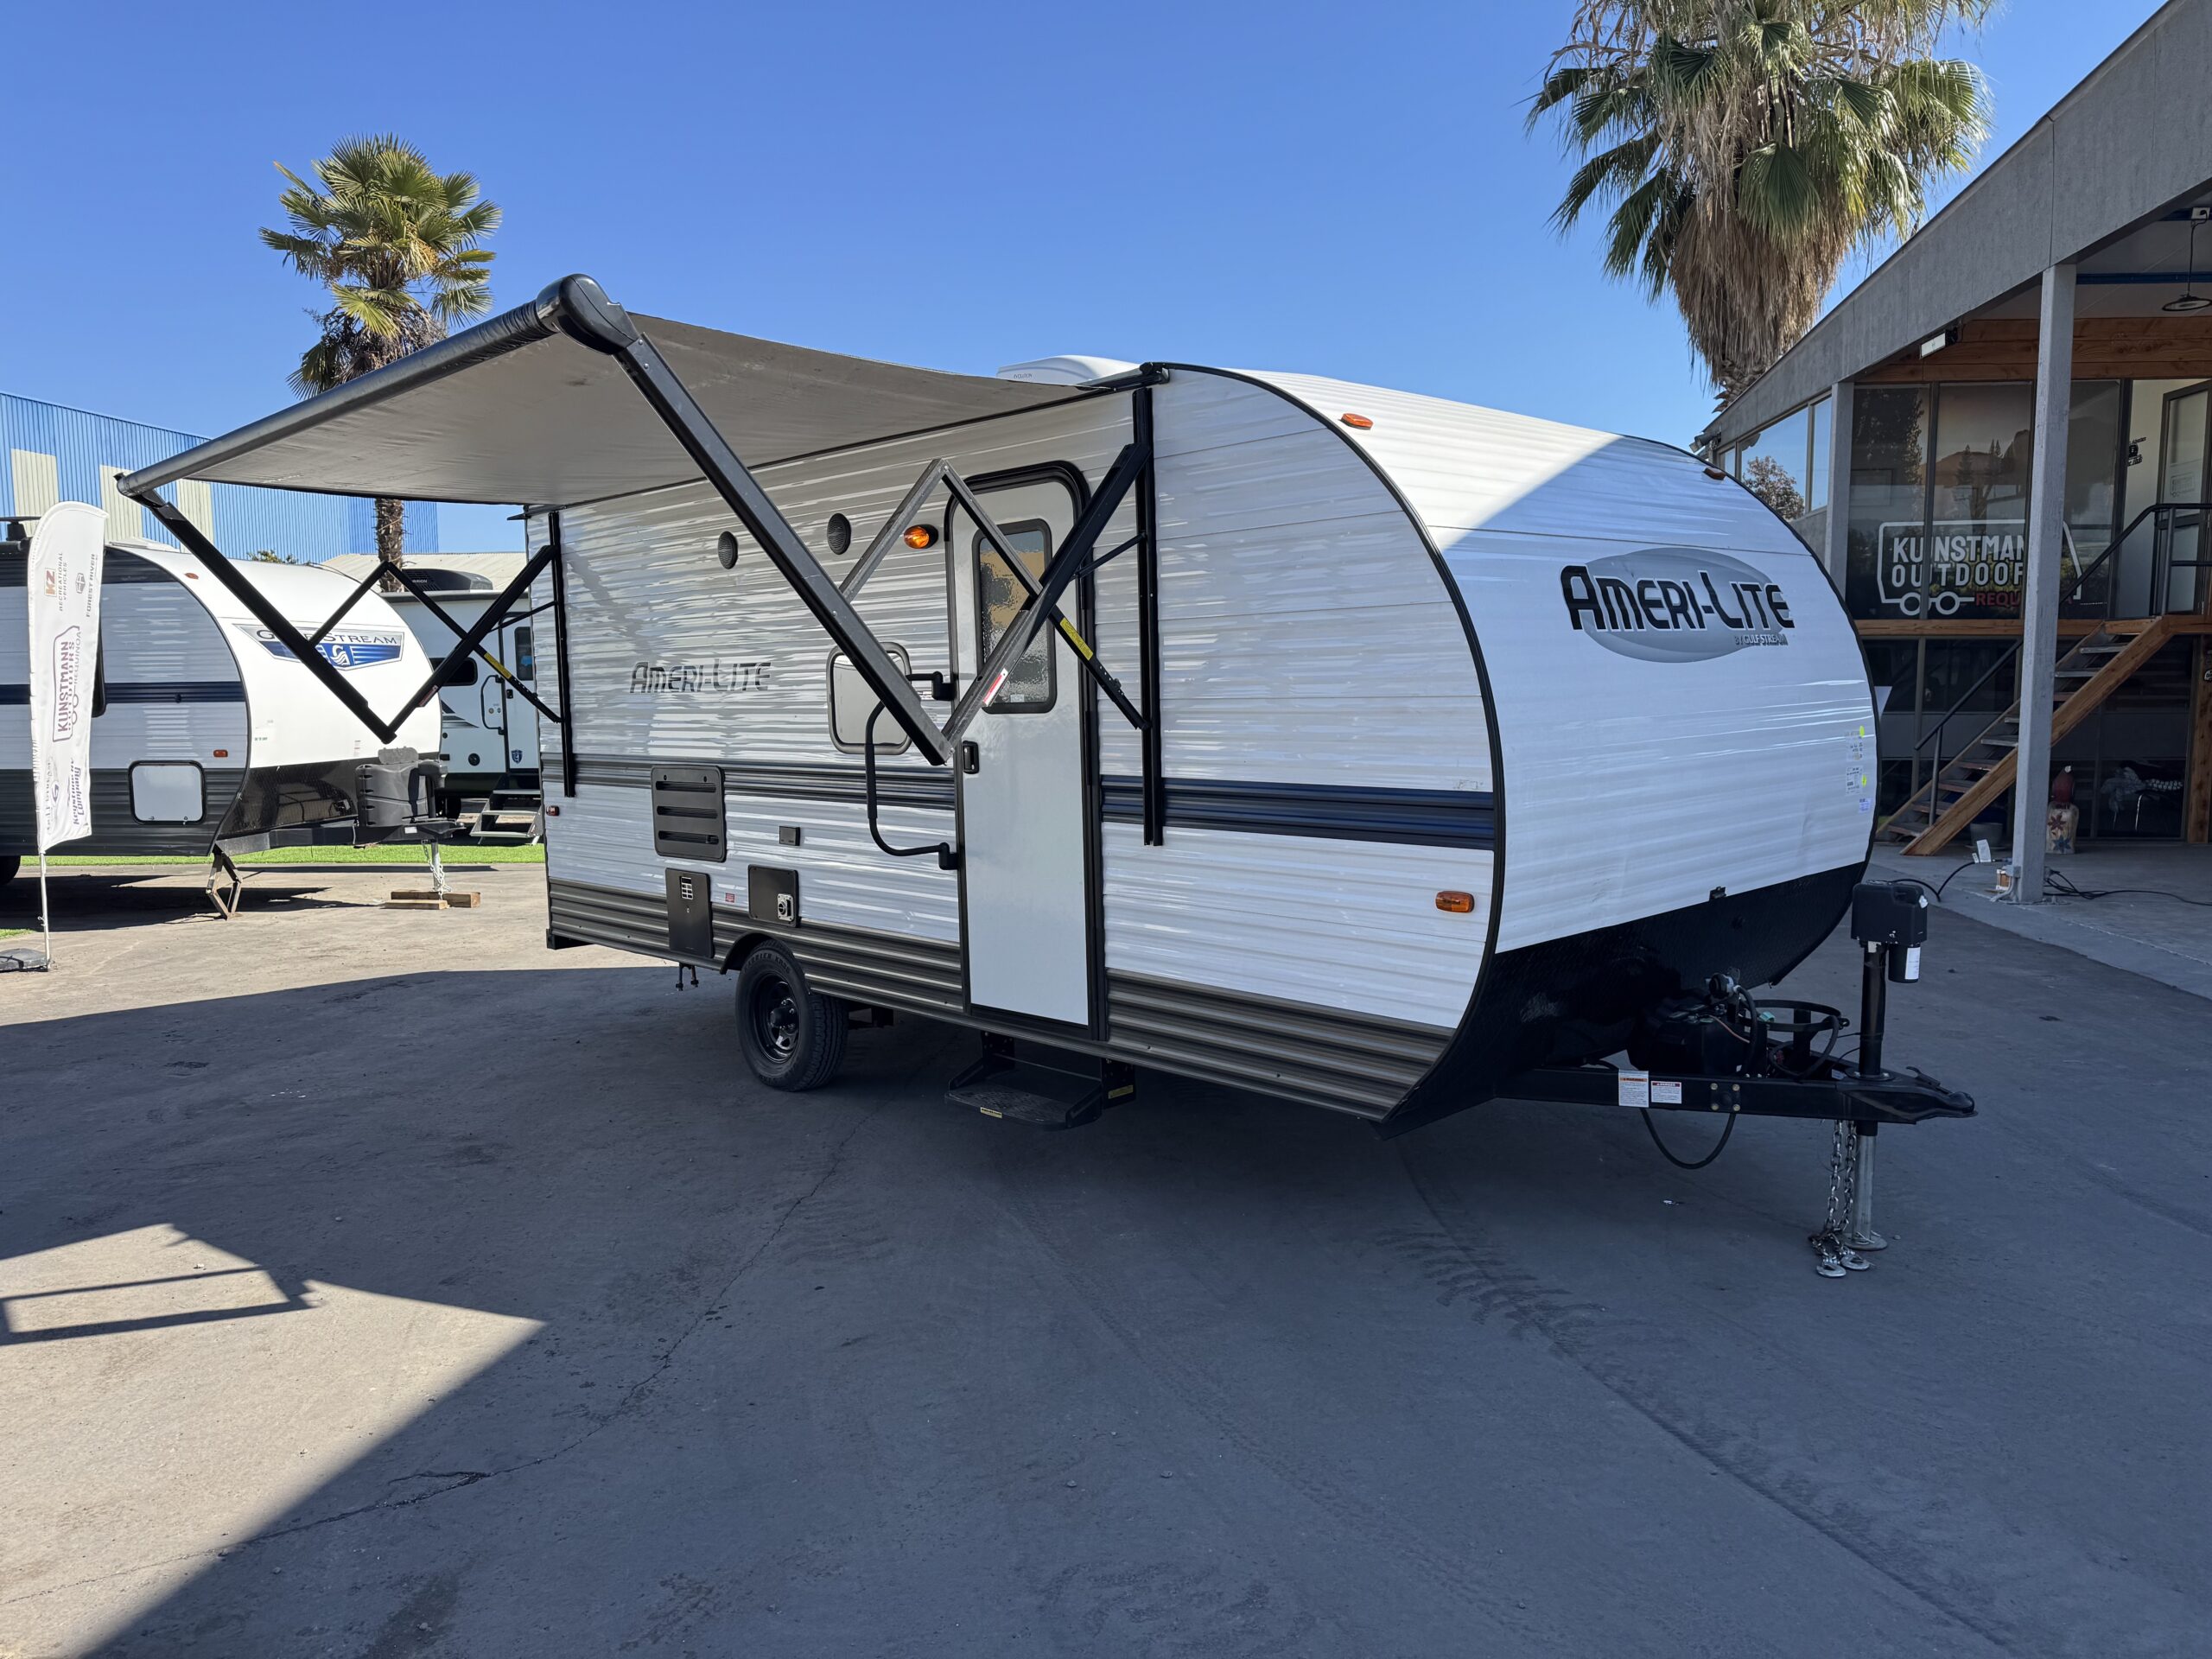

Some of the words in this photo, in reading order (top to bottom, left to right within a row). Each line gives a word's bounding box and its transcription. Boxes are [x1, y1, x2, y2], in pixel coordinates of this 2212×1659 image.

[1892, 535, 2024, 563] KUNSTMAN
[45, 570, 55, 595] KZ
[323, 632, 397, 645] STREAM
[57, 641, 68, 733] KUNSTMANN
[73, 766, 85, 816] Company
